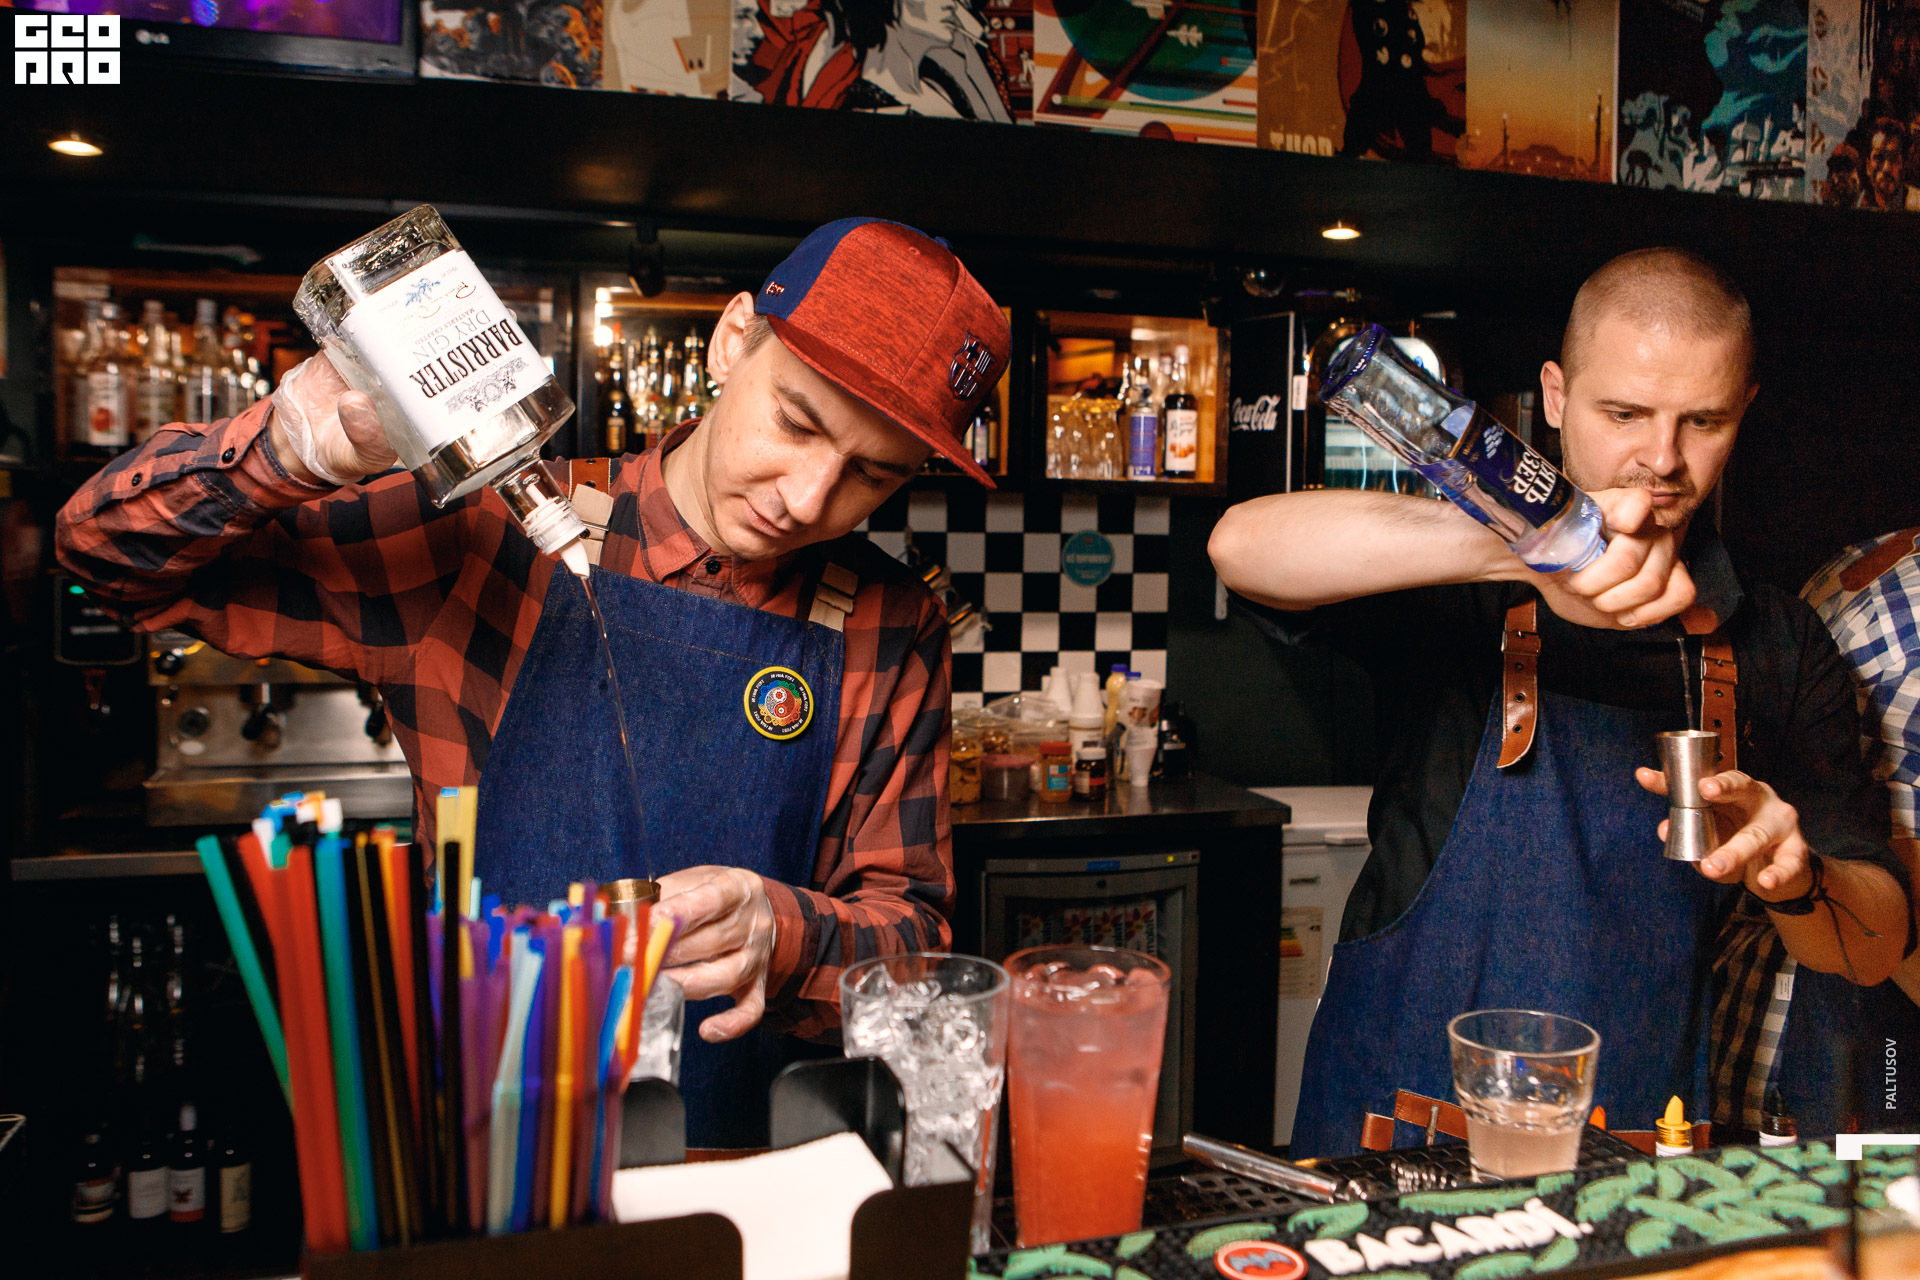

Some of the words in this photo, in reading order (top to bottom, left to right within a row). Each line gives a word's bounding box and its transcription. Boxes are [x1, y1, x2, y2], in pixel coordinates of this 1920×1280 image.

[444, 308, 475, 329] MASTERLY
[455, 309, 491, 340] DRY
[409, 318, 523, 399] BARRISTER
[413, 334, 450, 364] GIN
